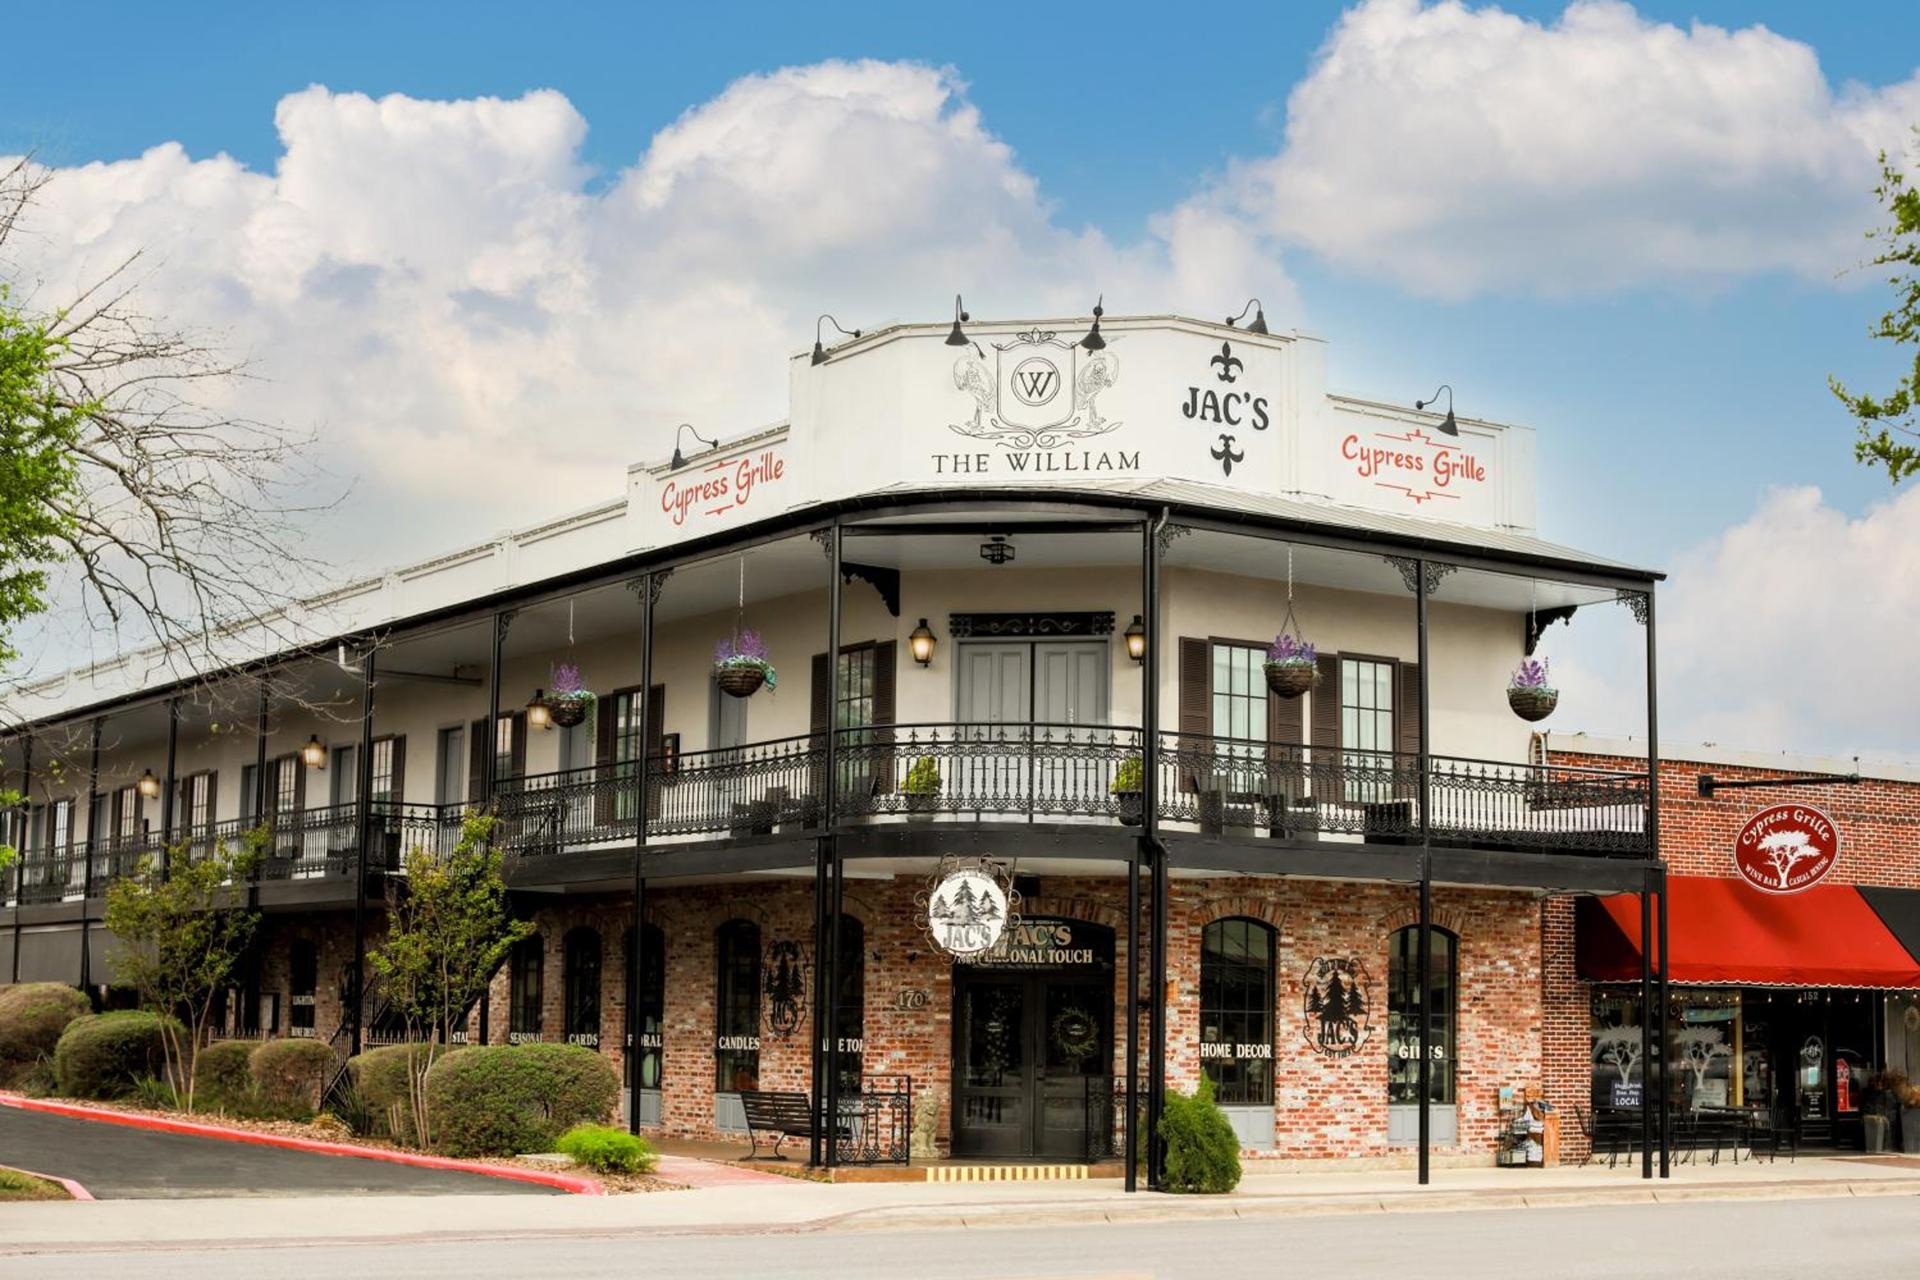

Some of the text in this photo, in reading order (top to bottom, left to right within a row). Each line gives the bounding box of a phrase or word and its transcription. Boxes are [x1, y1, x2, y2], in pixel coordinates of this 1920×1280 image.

[1017, 371, 1055, 398] W
[1182, 386, 1270, 431] JAC'S
[931, 451, 1141, 474] THE WILLIAM
[1341, 434, 1486, 487] Cypress Grille
[661, 453, 785, 525] Cypress Grille
[1742, 809, 1831, 846] Cypress Grille
[1745, 863, 1778, 887] WINE BAR
[943, 925, 992, 948] JAC'S
[1049, 949, 1093, 964] TOUCH
[899, 992, 924, 1007] 170
[569, 1033, 598, 1046] CARDS
[627, 1034, 662, 1048] FRAL
[718, 1036, 761, 1050] CANDLES
[1200, 1043, 1272, 1058] HOME DECOR
[1615, 1097, 1640, 1106] LOCAL
